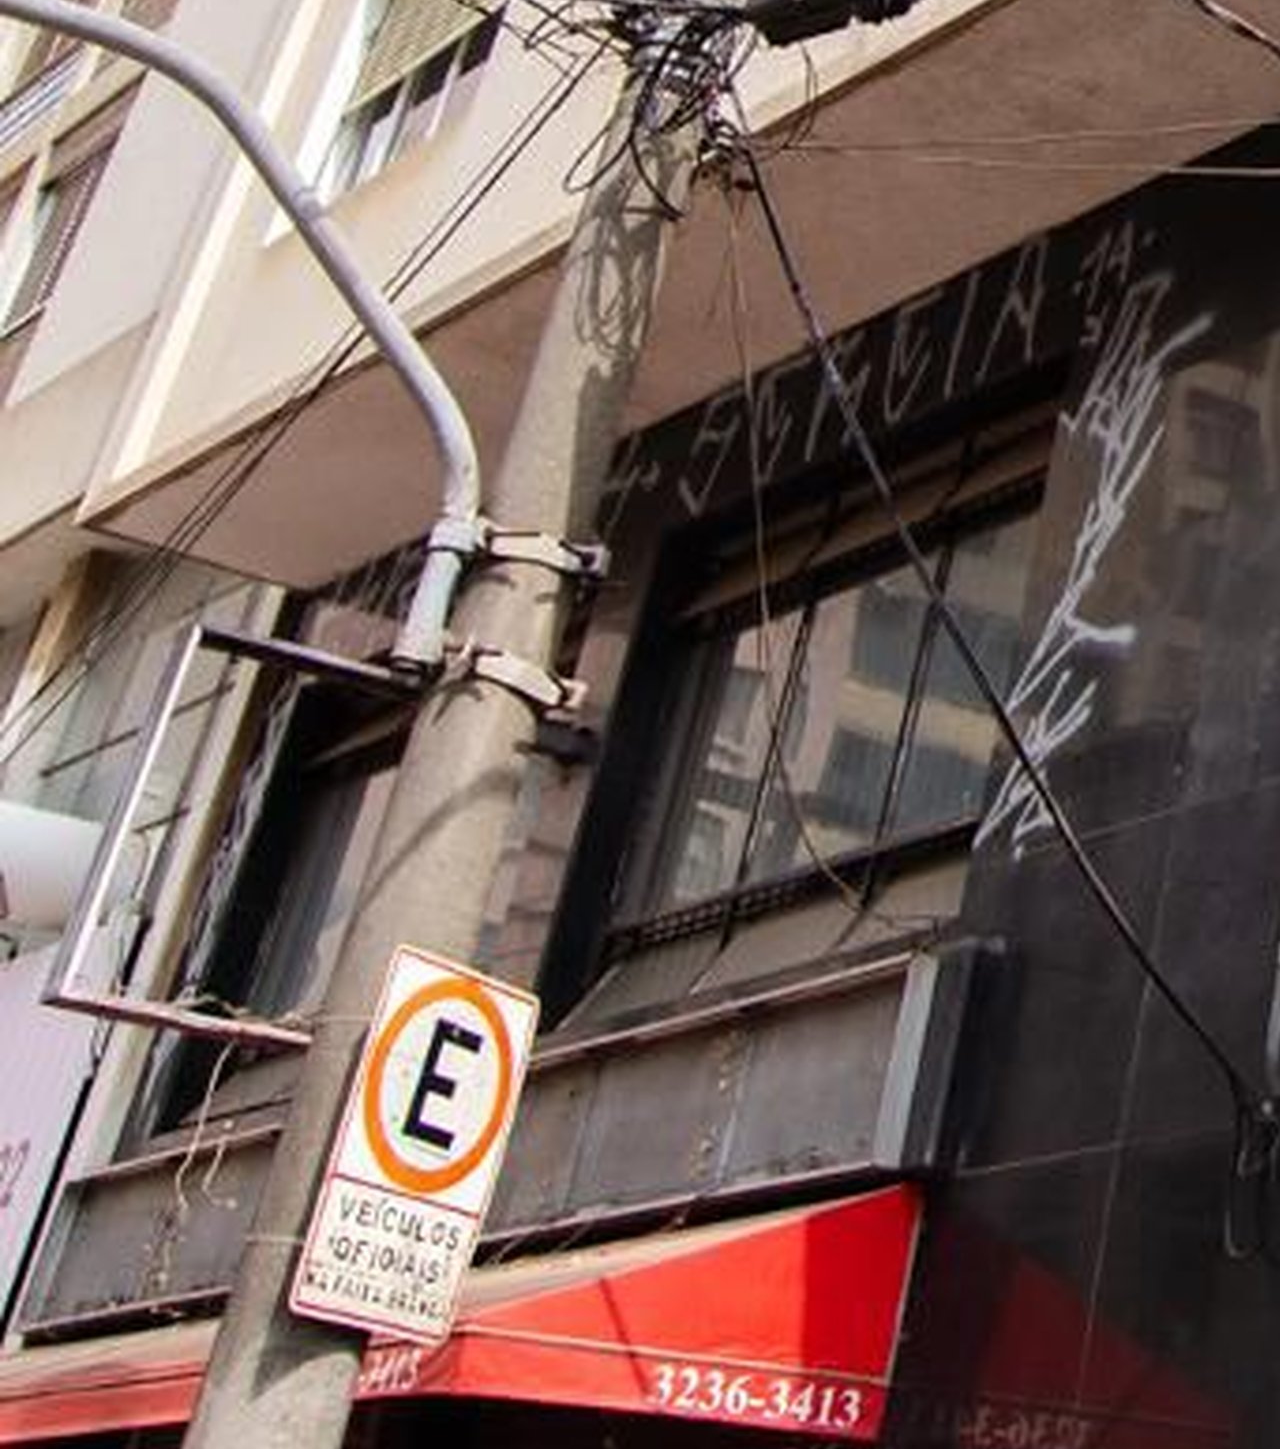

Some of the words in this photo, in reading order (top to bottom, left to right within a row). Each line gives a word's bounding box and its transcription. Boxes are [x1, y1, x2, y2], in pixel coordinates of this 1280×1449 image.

[402, 1018, 483, 1150] E
[339, 1195, 463, 1250] VEÍCULOS
[648, 1363, 862, 1428] 3236-3413
